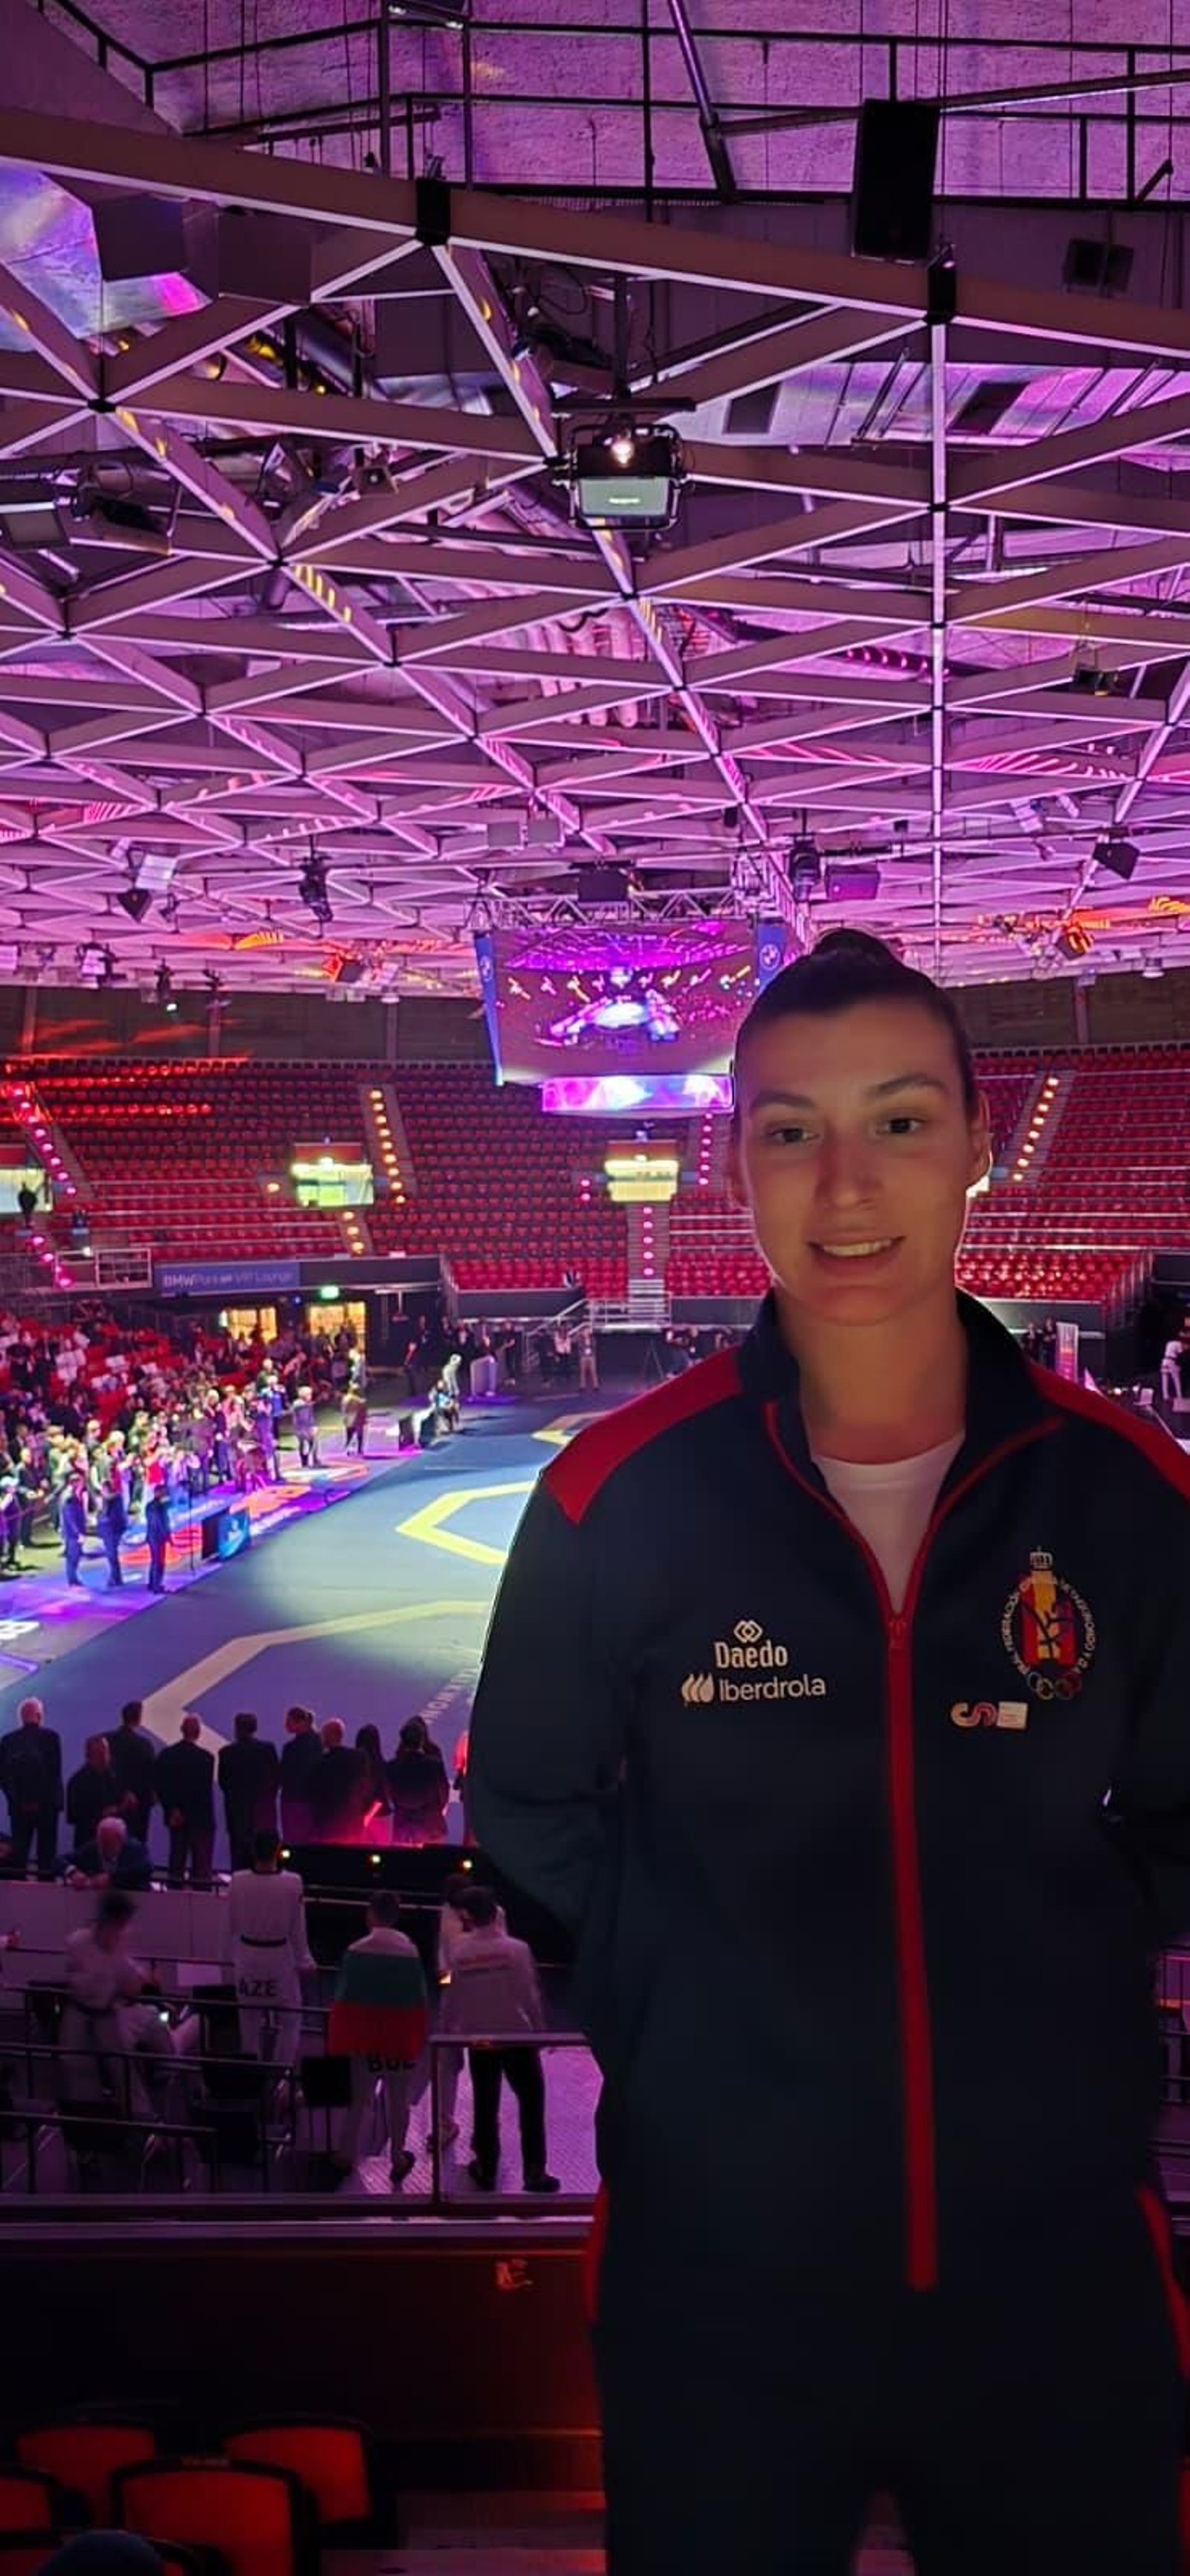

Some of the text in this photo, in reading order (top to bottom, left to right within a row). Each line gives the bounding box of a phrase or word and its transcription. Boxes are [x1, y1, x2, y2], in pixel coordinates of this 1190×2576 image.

[714, 1639, 788, 1668] Daedo
[718, 1673, 826, 1701] Iberdrola
[239, 1977, 278, 1997] AZE
